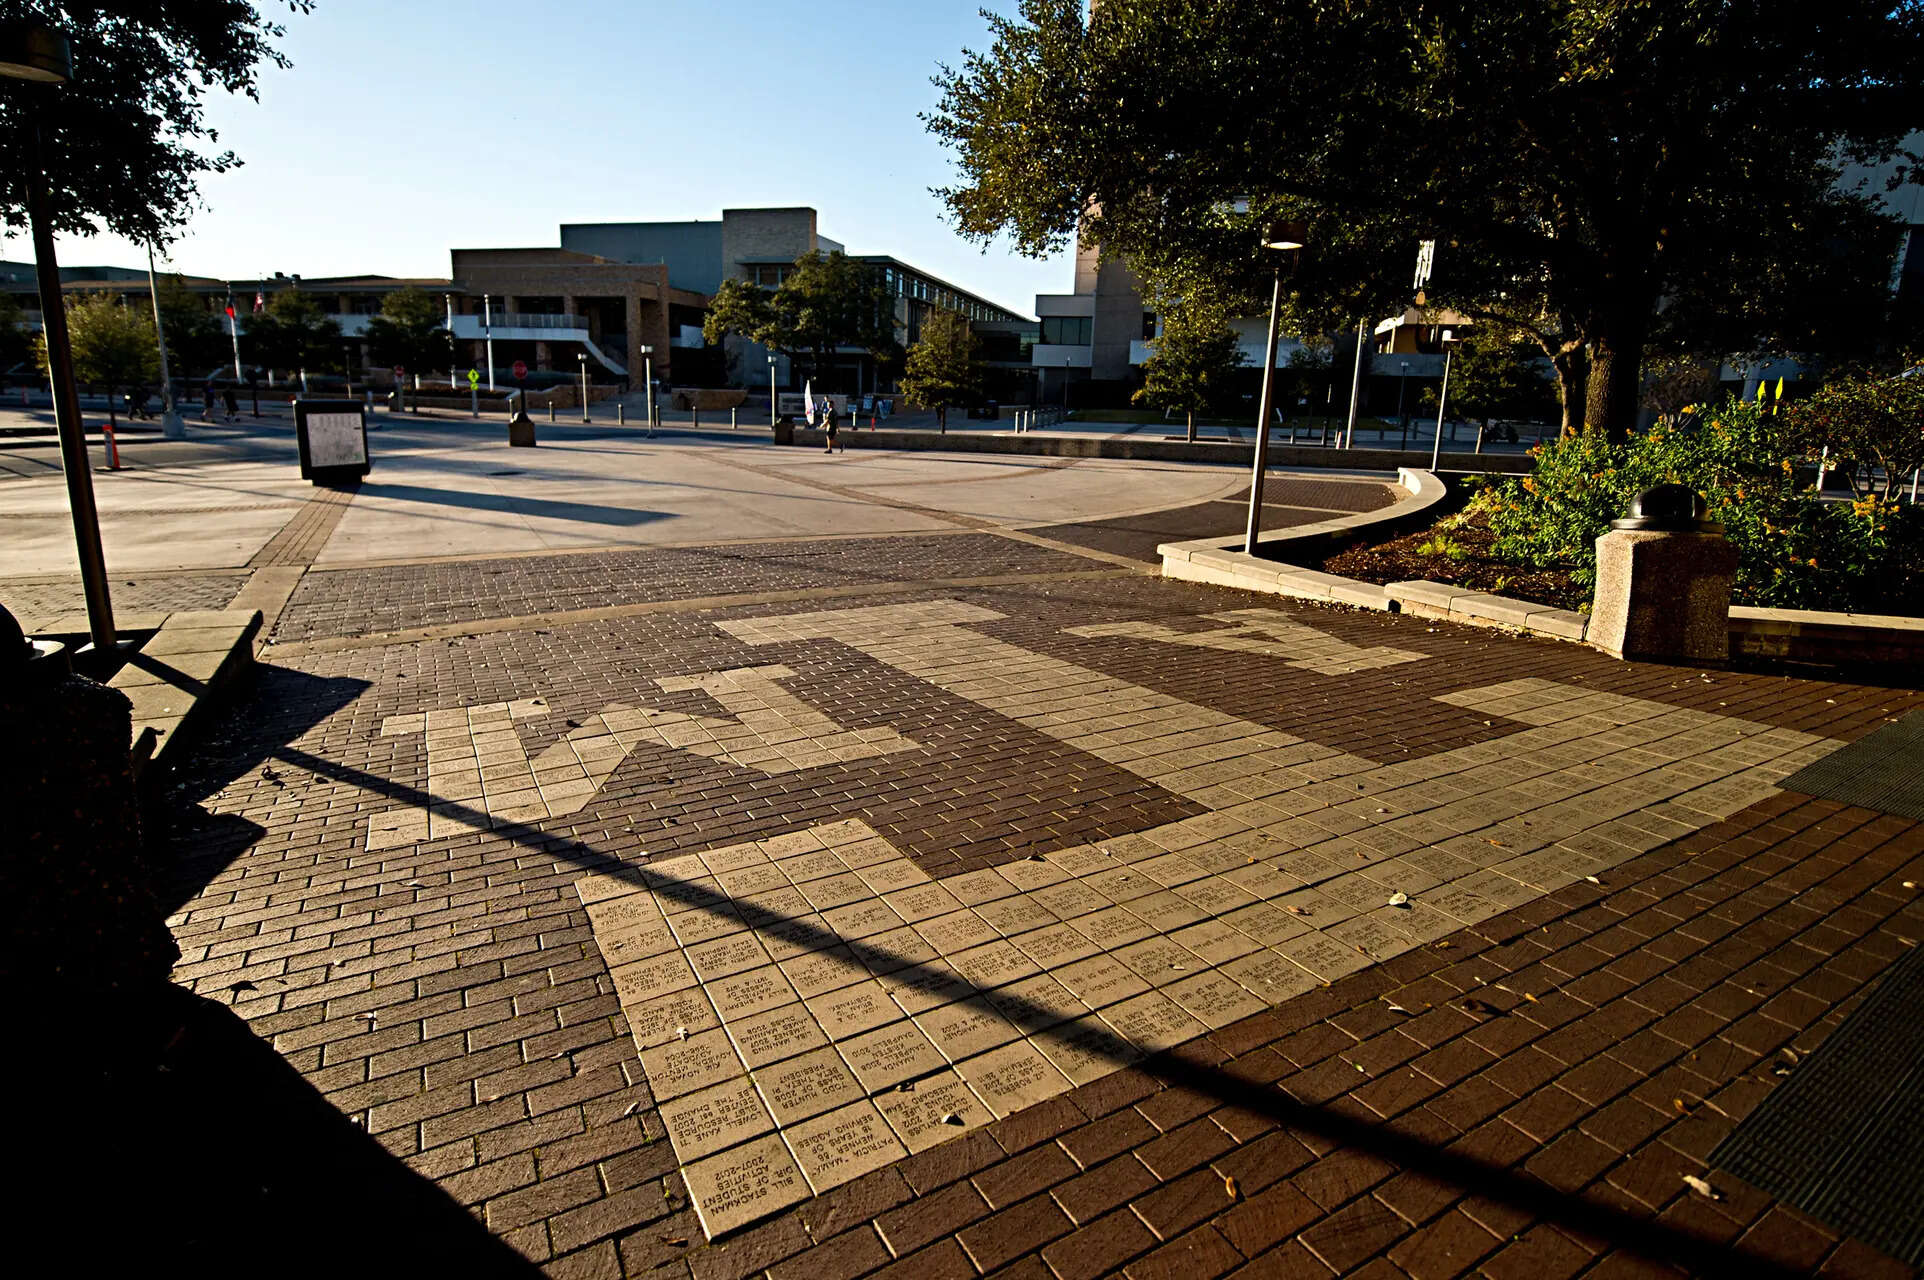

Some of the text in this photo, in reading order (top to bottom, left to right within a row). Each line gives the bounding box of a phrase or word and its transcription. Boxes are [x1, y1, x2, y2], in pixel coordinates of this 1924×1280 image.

[871, 1031, 914, 1049] CAMPBELL
[665, 1049, 712, 1068] ADVOCATE
[870, 1042, 906, 1059] KRISTEN
[882, 1042, 927, 1063] CAMPBELL
[650, 1064, 689, 1082] MENTOR
[668, 1061, 722, 1083] KIM NOVAK
[777, 1062, 825, 1084] PRESIDENT
[815, 1066, 839, 1079] BETA
[880, 1055, 917, 1072] AMANDA
[1016, 1062, 1045, 1077] CLASS
[783, 1074, 814, 1090] THETA
[799, 1083, 814, 1093] OF
[815, 1072, 845, 1087] CLASS
[992, 1076, 1032, 1096] ROBERTS
[717, 1095, 755, 1114] CENTER
[780, 1080, 848, 1109] TODD HUNTER
[882, 1080, 961, 1115] WAKEBOARD TEAM
[669, 1089, 750, 1123] BE THE CHANGE
[900, 1092, 956, 1118] YOUNG LIFE
[900, 1096, 969, 1128] CLASS OF 2012
[671, 1116, 695, 1131] 2007
[676, 1113, 729, 1138] RESOURCE
[724, 1110, 763, 1130] LOWELL
[694, 1125, 721, 1141] KANE
[796, 1113, 874, 1148] SERVING AGGIES
[827, 1130, 857, 1146] YEARS
[809, 1142, 825, 1153] OF
[851, 1136, 895, 1158] PATRICIA
[713, 1155, 765, 1181] 2007-2012
[715, 1164, 770, 1191] ACTIVITIES
[752, 1174, 770, 1188] OF
[700, 1182, 751, 1208] STUDENT
[709, 1176, 794, 1216] BILL STACKMAN
